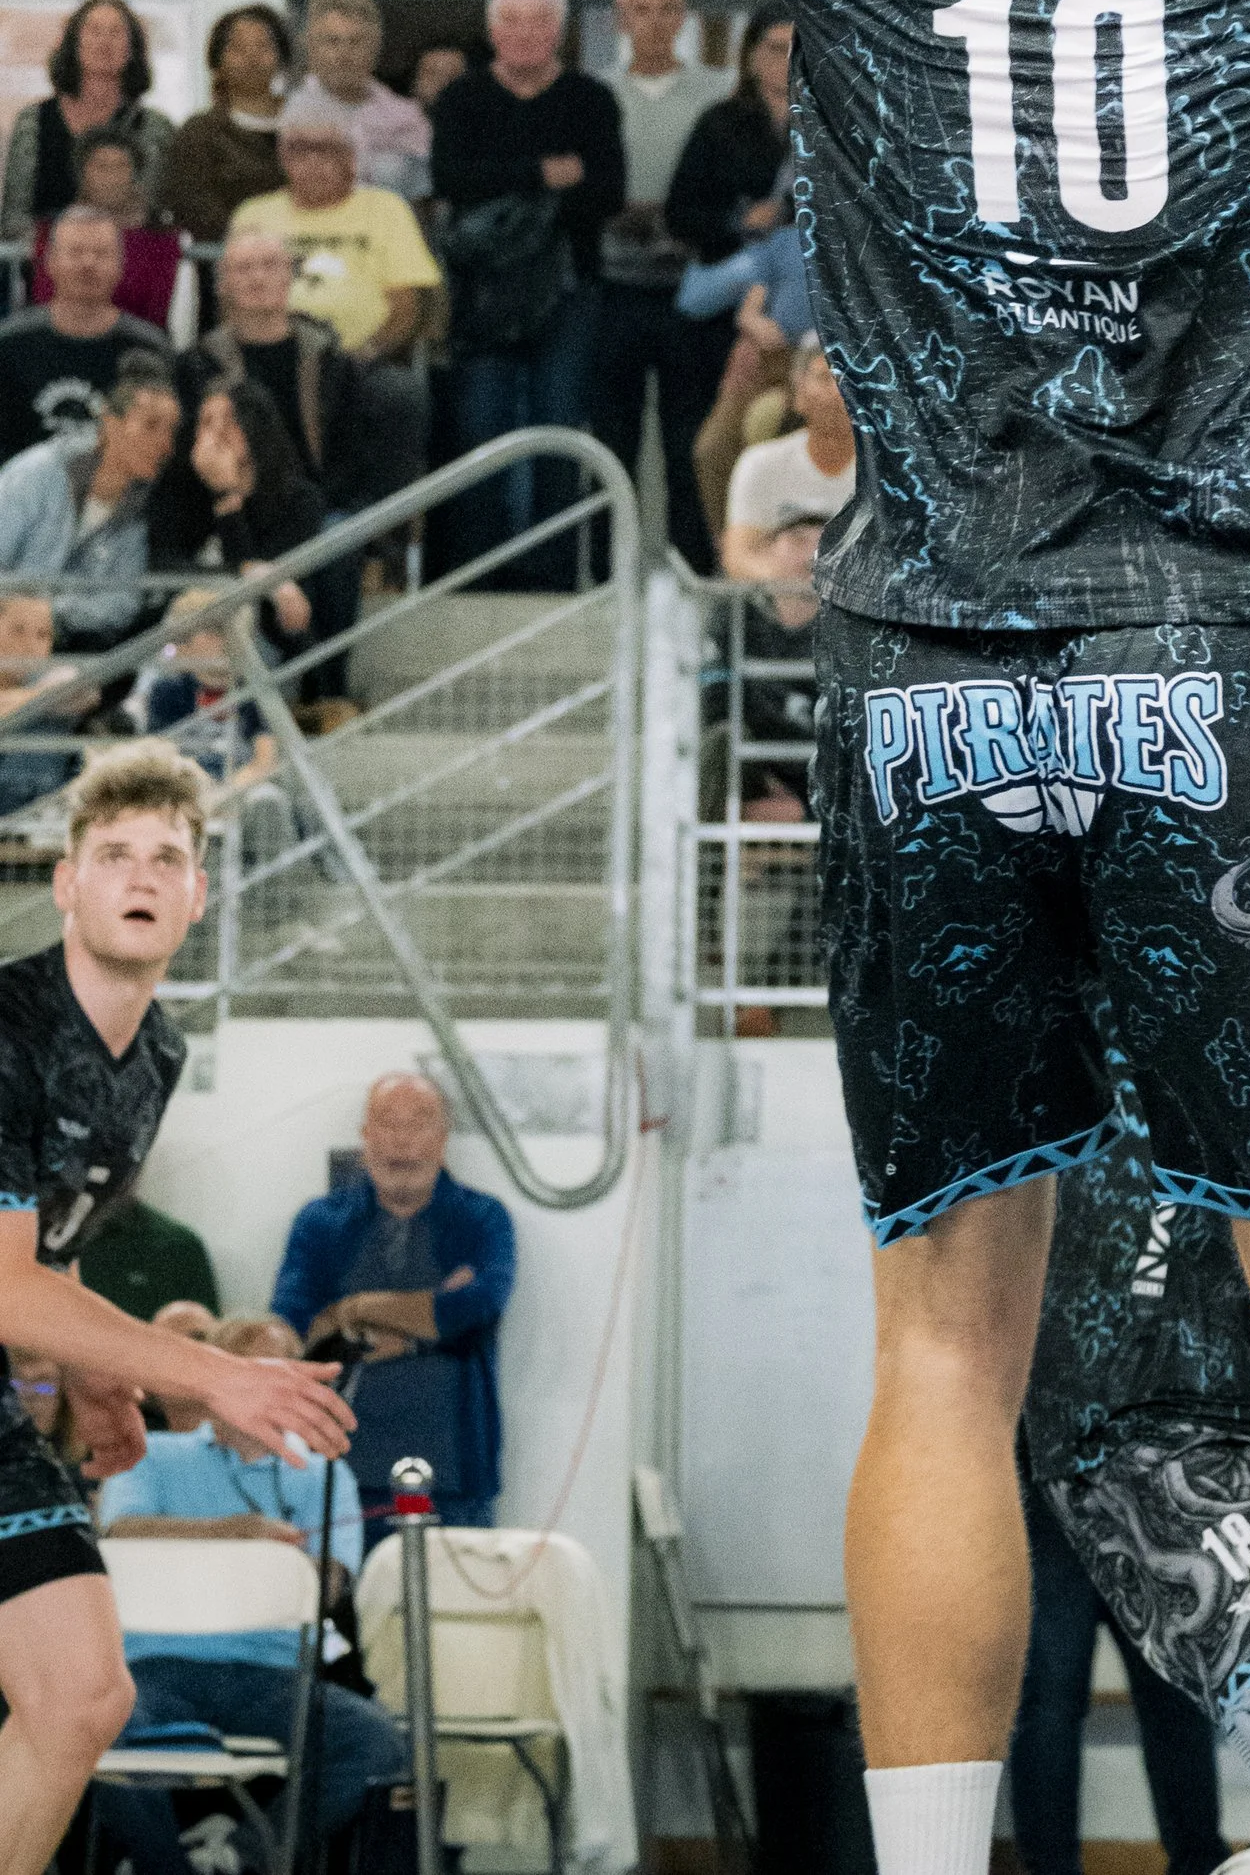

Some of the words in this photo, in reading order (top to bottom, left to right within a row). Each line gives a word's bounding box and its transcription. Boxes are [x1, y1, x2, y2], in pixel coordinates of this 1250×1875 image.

[983, 275, 1139, 314] ROYAN
[990, 301, 1142, 345] ATLANTIQUE
[864, 670, 1229, 825] PIRATES
